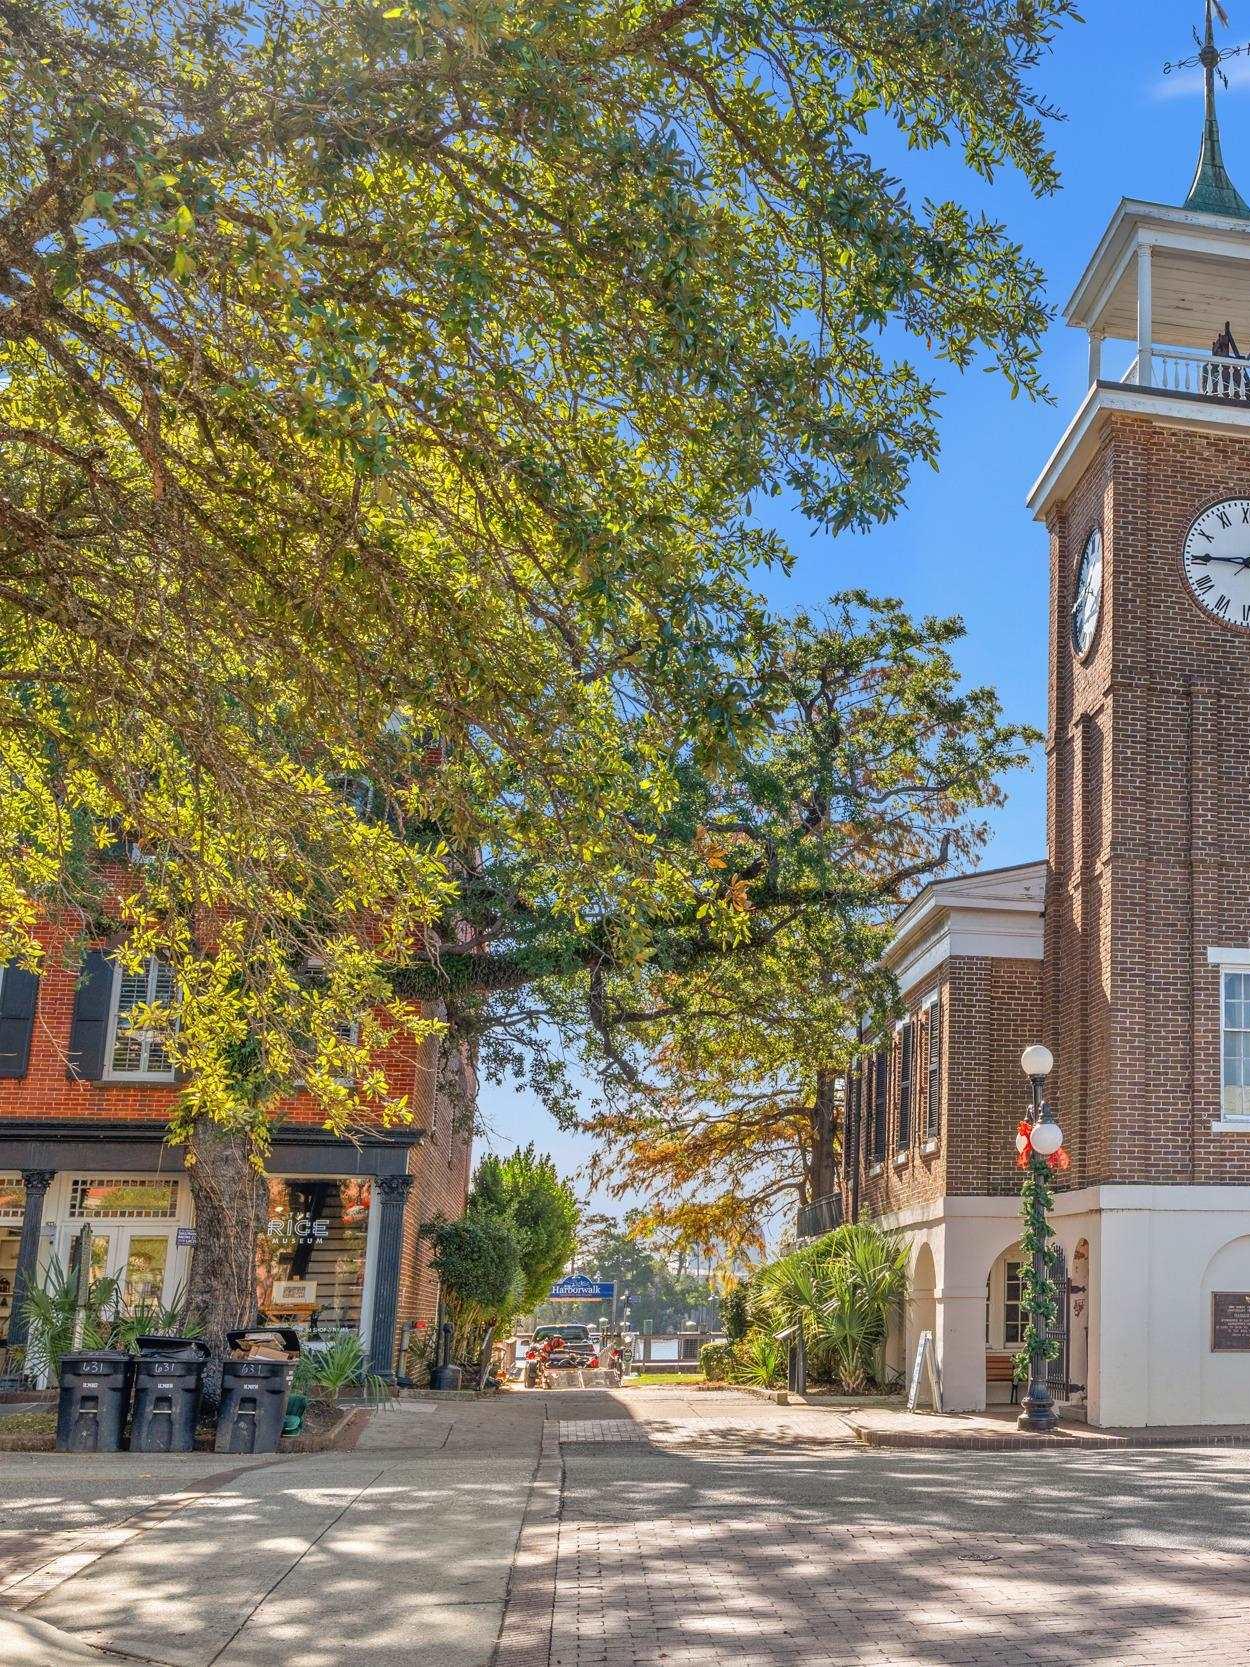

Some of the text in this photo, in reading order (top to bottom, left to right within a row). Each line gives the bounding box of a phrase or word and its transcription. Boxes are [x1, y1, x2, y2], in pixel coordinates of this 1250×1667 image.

[1216, 510, 1232, 529] XI
[1198, 528, 1215, 543] X
[267, 1220, 329, 1236] RICE
[552, 1286, 600, 1294] Harborwalk
[82, 1361, 104, 1373] 631
[155, 1362, 175, 1374] 631
[240, 1362, 261, 1375] 631
